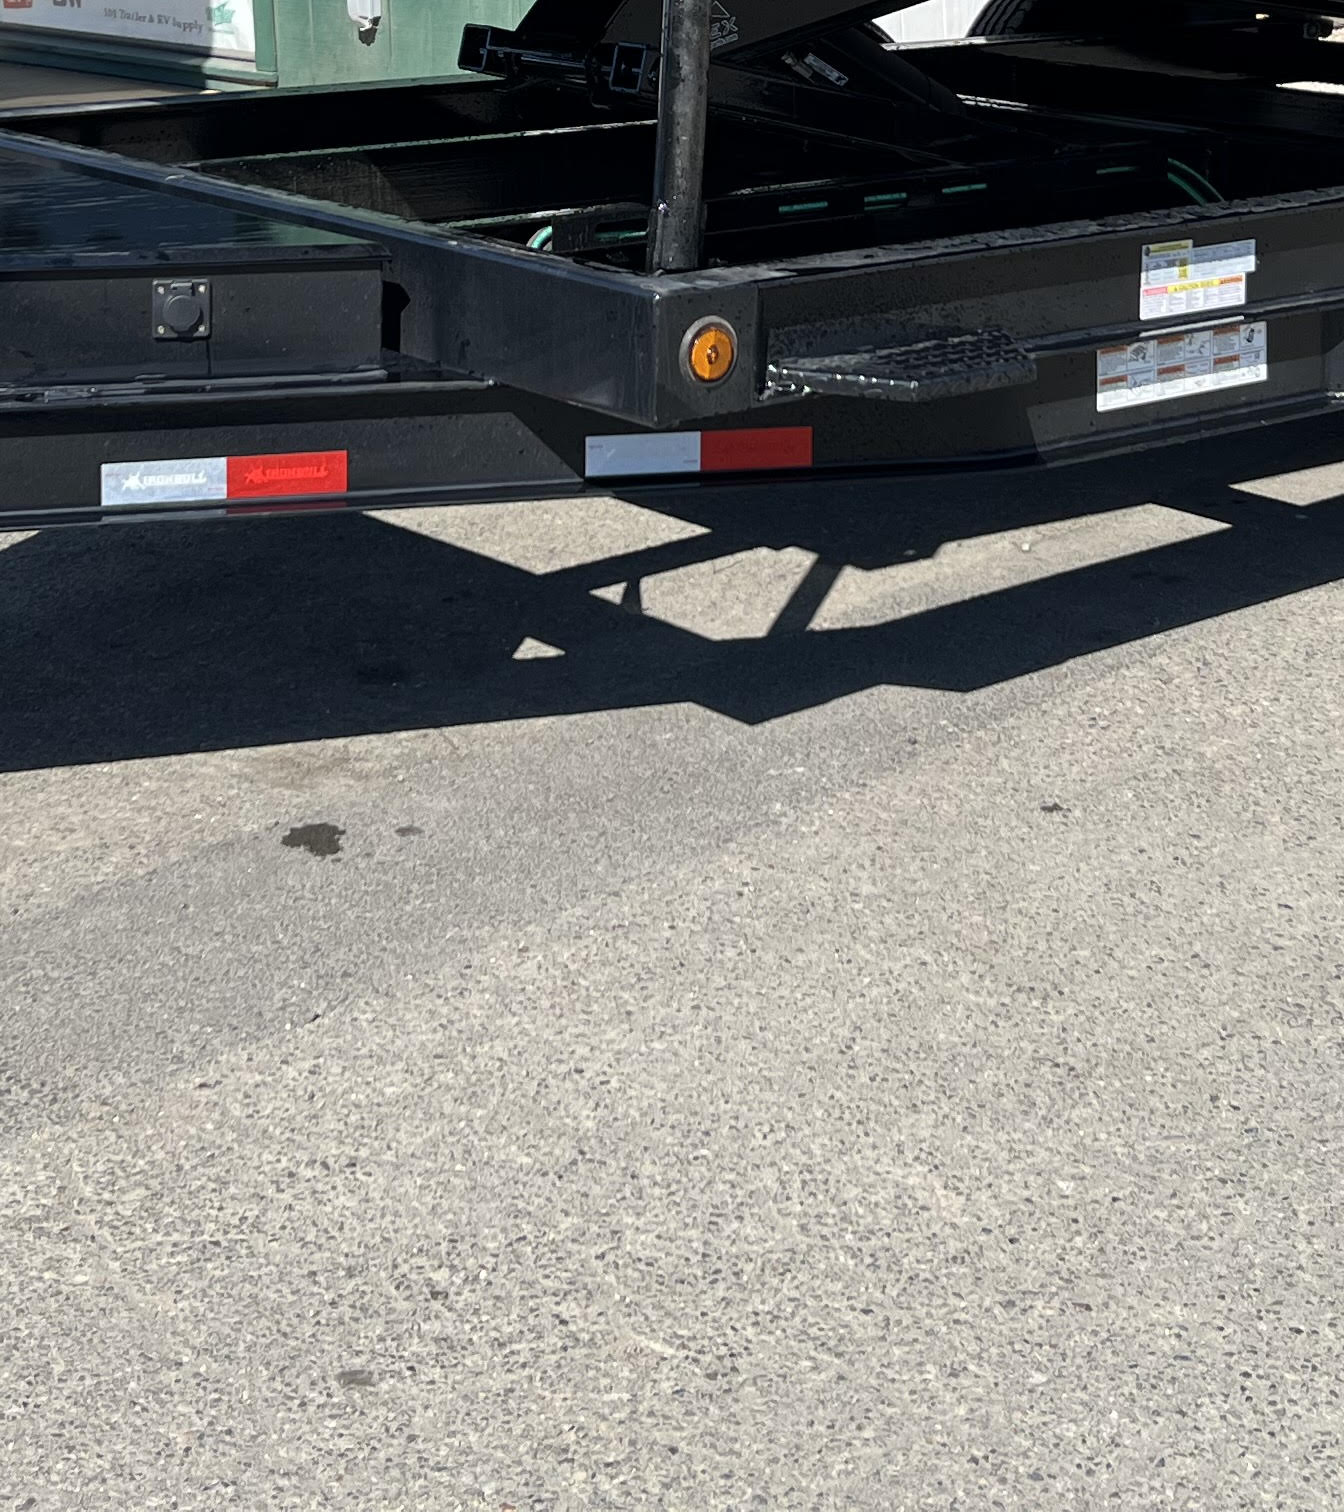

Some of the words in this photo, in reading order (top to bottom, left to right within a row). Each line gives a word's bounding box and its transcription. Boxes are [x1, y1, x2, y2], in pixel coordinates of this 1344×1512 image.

[119, 8, 146, 23] Trailer
[157, 14, 172, 25] RV
[143, 470, 207, 486] IRONBULL
[265, 463, 329, 480] IRONBULL
